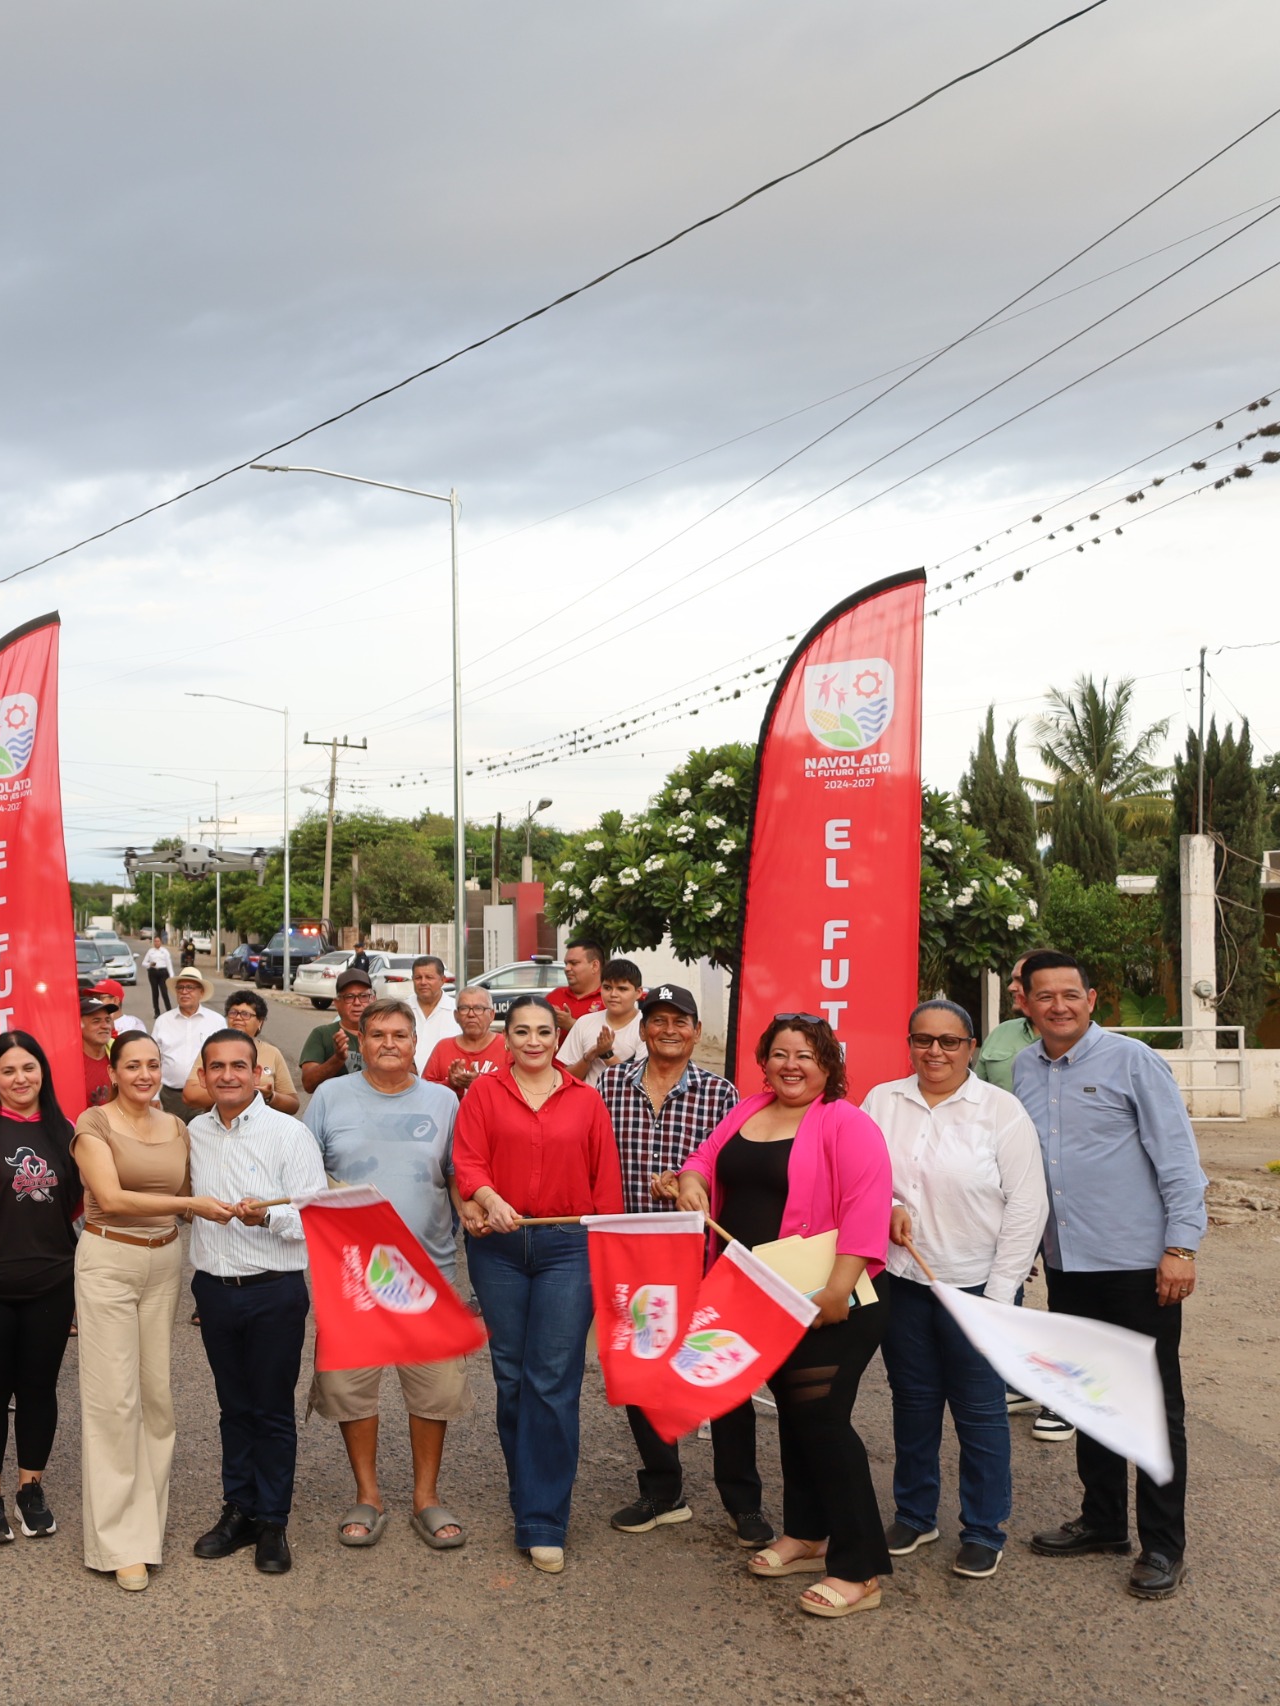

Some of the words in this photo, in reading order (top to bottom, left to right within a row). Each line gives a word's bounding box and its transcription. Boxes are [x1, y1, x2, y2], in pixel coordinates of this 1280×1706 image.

[804, 752, 891, 770] NAVOLATO
[804, 770, 816, 778] EL
[817, 768, 855, 777] FUTURO
[856, 767, 871, 777] ¡ES
[872, 765, 891, 774] HOY!
[824, 777, 875, 790] 2024-2027
[824, 818, 851, 888] EL
[659, 986, 673, 1000] LA
